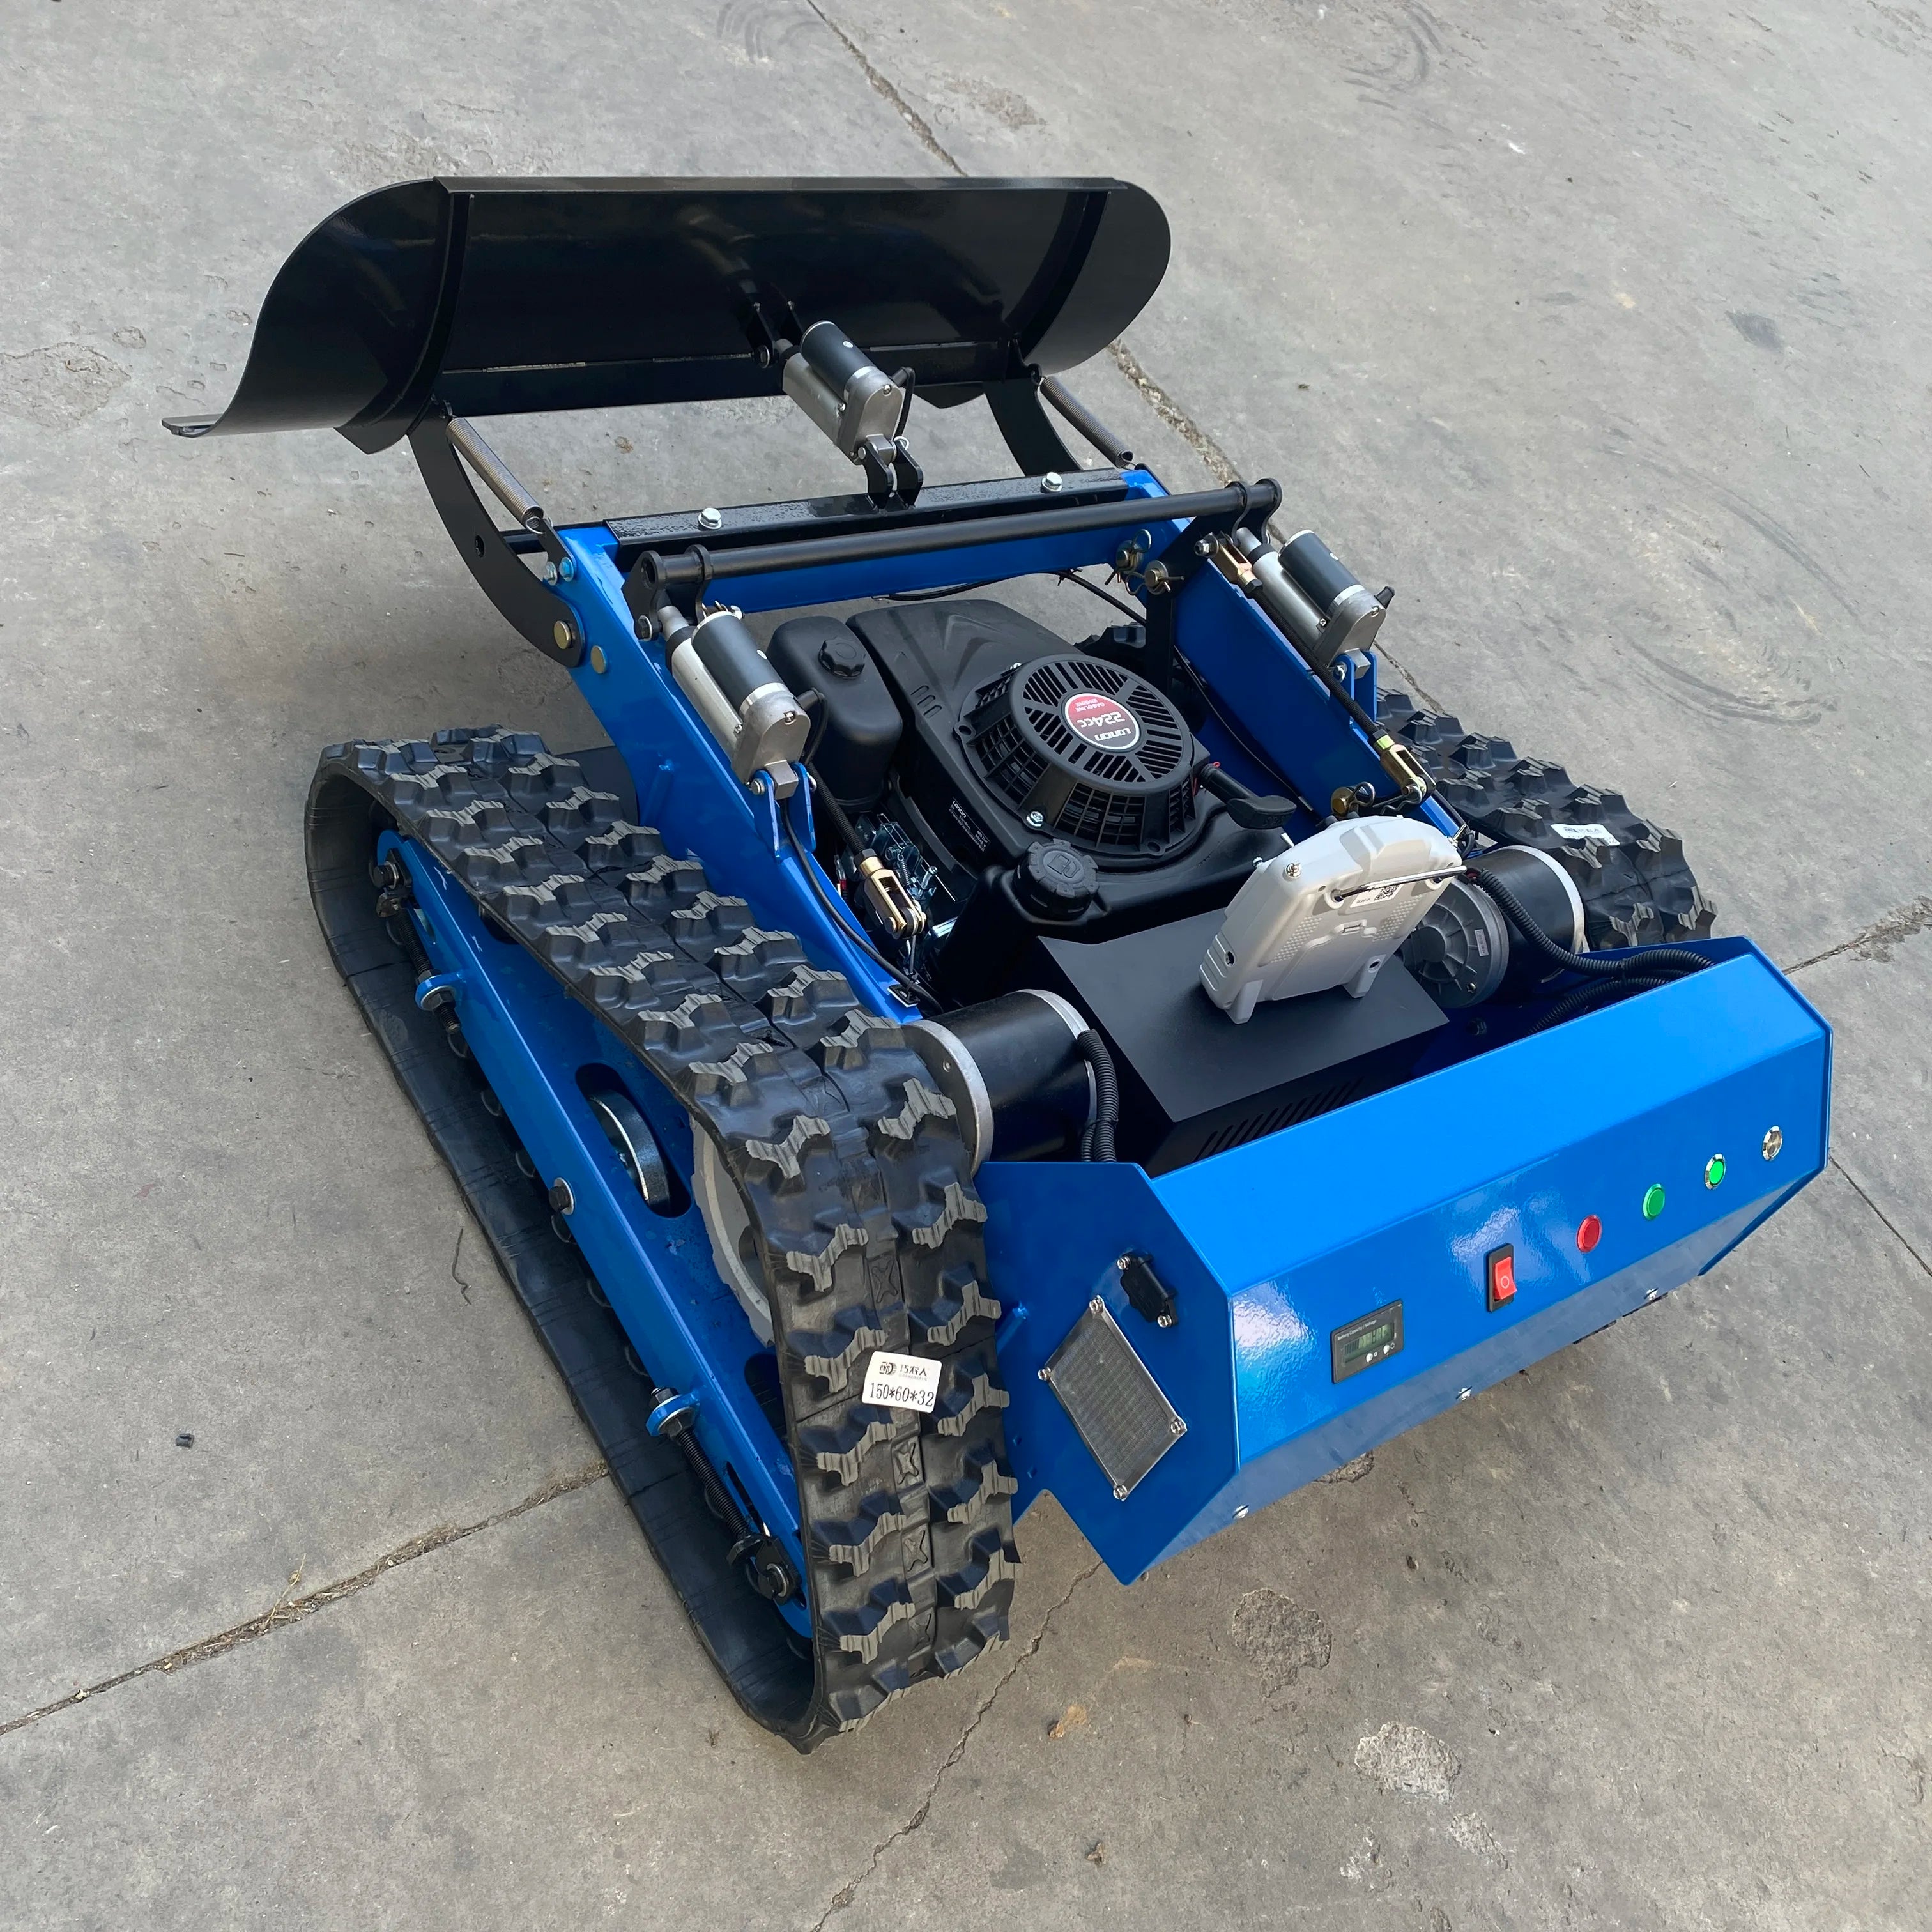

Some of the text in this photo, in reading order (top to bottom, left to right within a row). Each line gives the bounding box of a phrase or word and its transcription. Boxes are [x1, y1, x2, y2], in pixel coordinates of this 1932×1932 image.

[1075, 698, 1098, 707] ENGINE
[1075, 702, 1105, 712] GASOLINE
[1349, 1326, 1363, 1335] Capacity
[1365, 1319, 1377, 1328] Voltage
